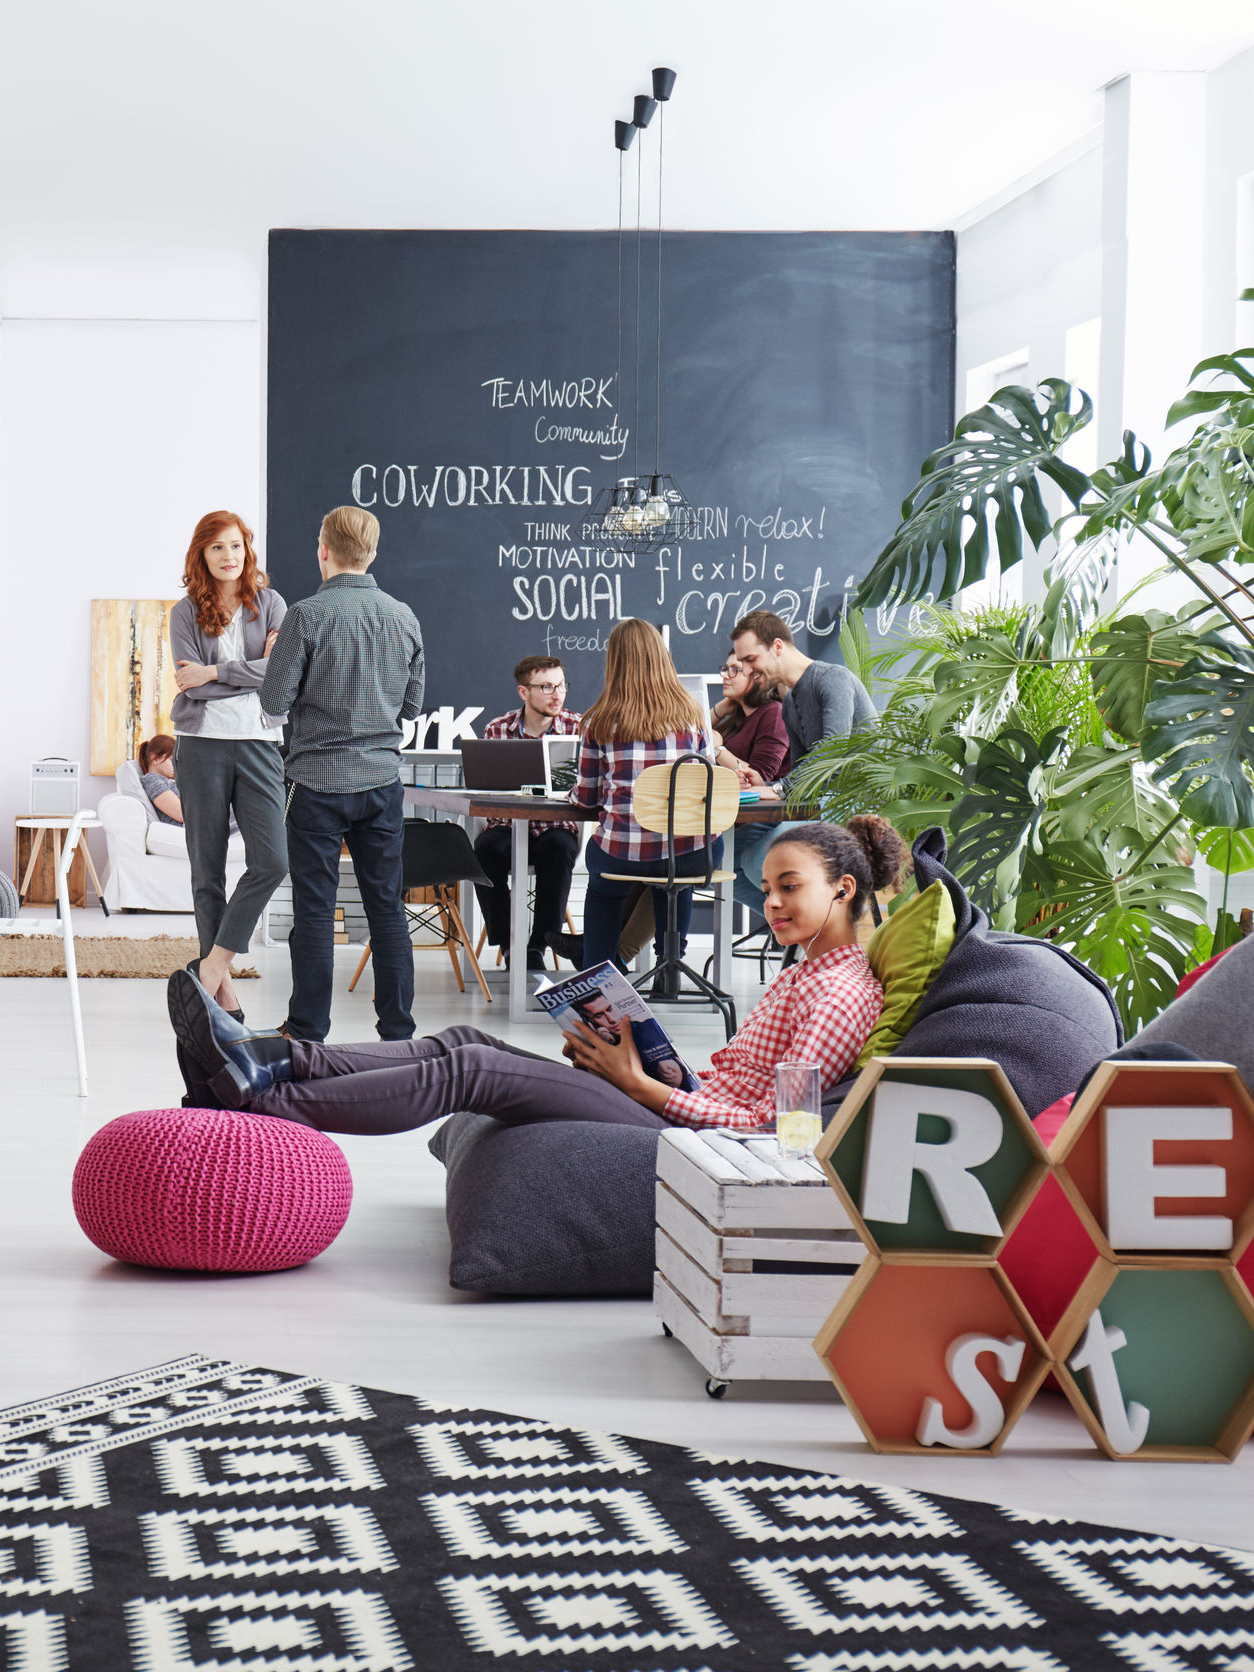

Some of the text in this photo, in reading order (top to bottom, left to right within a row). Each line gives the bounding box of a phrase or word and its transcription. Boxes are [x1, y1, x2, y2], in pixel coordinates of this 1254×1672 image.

[481, 376, 614, 408] TEAMWORK
[535, 413, 629, 460] Community
[351, 464, 592, 508] COWORKING
[524, 522, 572, 541] THINK
[735, 506, 826, 539] relax!
[498, 545, 636, 569] MOTIVATION
[655, 544, 785, 606] flexible
[511, 573, 636, 621] SOCIAL
[538, 967, 616, 1010] Business
